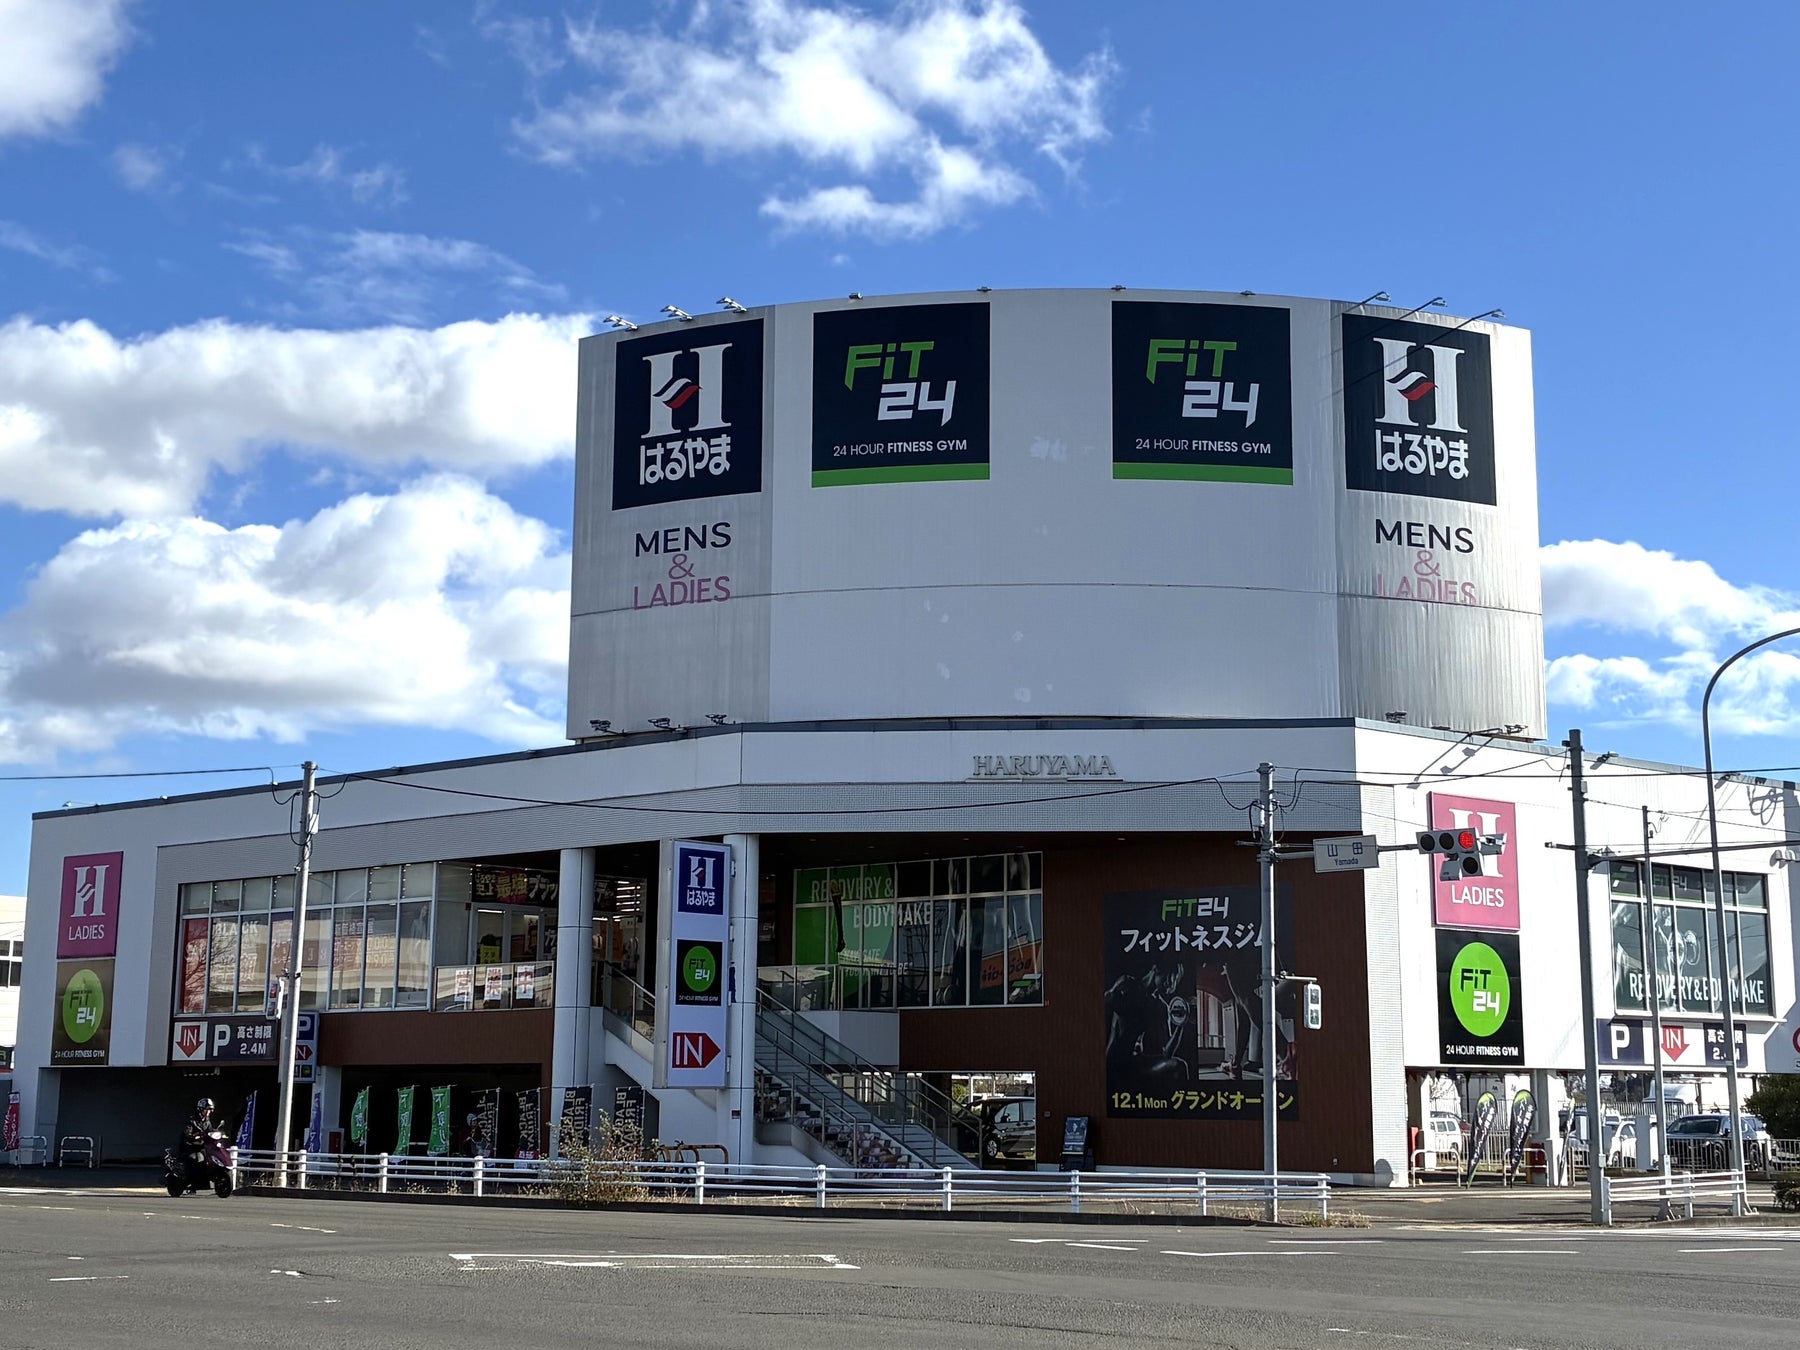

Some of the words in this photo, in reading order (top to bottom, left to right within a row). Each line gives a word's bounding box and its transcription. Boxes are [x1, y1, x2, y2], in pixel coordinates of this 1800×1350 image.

[877, 380, 957, 426] 24
[1181, 380, 1260, 428] 24
[833, 445, 847, 456] 24
[851, 443, 884, 455] HOUR
[888, 441, 933, 453] FITNESS
[937, 439, 967, 451] GYM
[1136, 439, 1150, 450] 24
[1154, 439, 1189, 450] HOUR
[1193, 440, 1238, 452] FITNESS
[1242, 442, 1271, 454] GYM
[1375, 429, 1469, 480] はるやま
[640, 434, 732, 485] はるやま
[635, 522, 732, 557] MENS
[1376, 519, 1474, 553] MENS
[668, 554, 695, 579] &
[1414, 550, 1440, 576] &
[633, 576, 732, 610] LADIES
[973, 755, 1116, 776] HARUYAMA
[1328, 842, 1363, 857] 山田
[1335, 857, 1359, 866] Yamada
[687, 890, 715, 906] はるやま
[811, 877, 881, 902] REOVERY
[1452, 884, 1504, 907] LADIES
[69, 924, 105, 941] LADIES
[694, 969, 710, 982] 24
[1472, 990, 1500, 1016] 24
[76, 1007, 96, 1027] 24
[184, 1029, 197, 1047] IN
[213, 1024, 231, 1057] P
[237, 1025, 272, 1039] 高さ制限
[1611, 1023, 1630, 1060] P
[1666, 1029, 1682, 1050] IN
[1707, 1029, 1744, 1043] 高さ限
[93, 1049, 105, 1057] GYM
[240, 1042, 267, 1055] 2.4M
[676, 1034, 703, 1066] IN
[1446, 1044, 1455, 1055] 24
[1455, 1045, 1475, 1055] HOUR
[1476, 1045, 1501, 1056] FITNESS
[1502, 1046, 1519, 1056] GYM
[1171, 1090, 1294, 1110] グランドオーン
